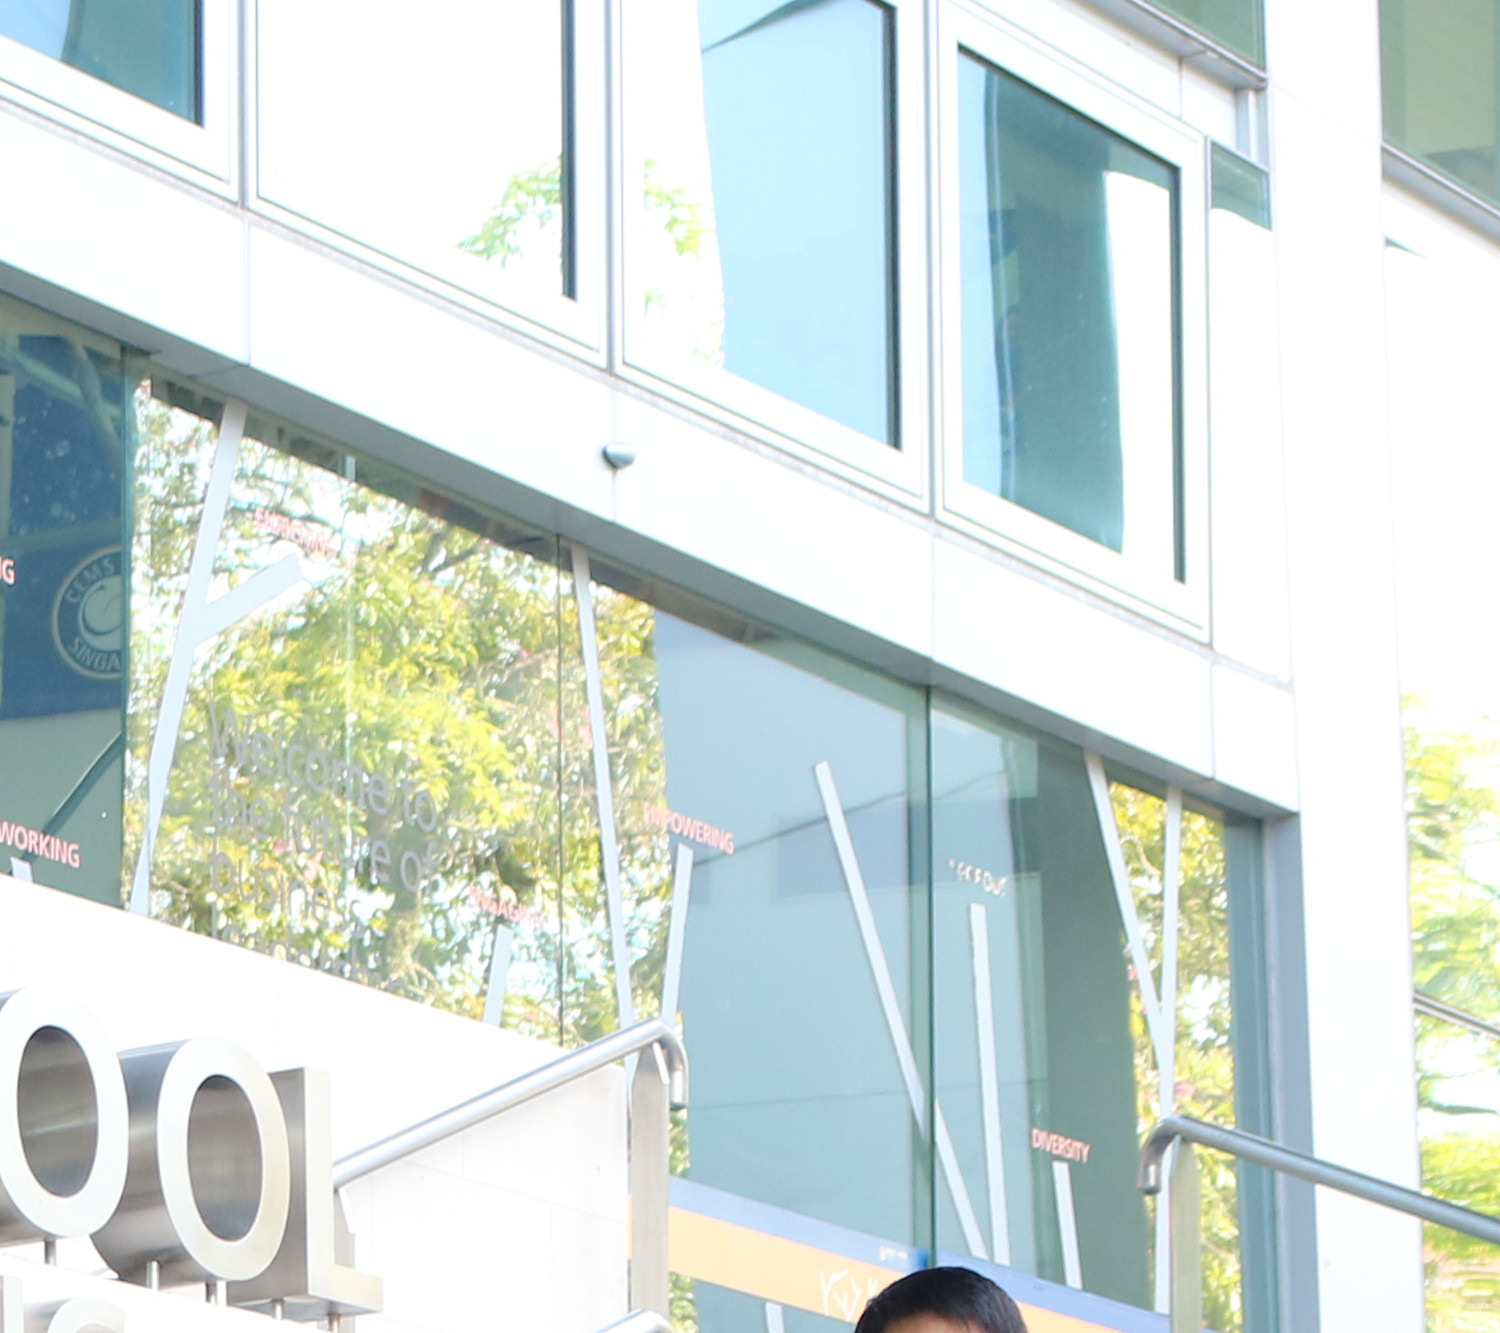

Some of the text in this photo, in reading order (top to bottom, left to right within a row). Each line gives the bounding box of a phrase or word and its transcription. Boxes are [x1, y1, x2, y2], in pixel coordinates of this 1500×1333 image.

[65, 556, 116, 605] CEMS
[401, 778, 438, 833] to
[1031, 1127, 1091, 1164] DIVERSITY
